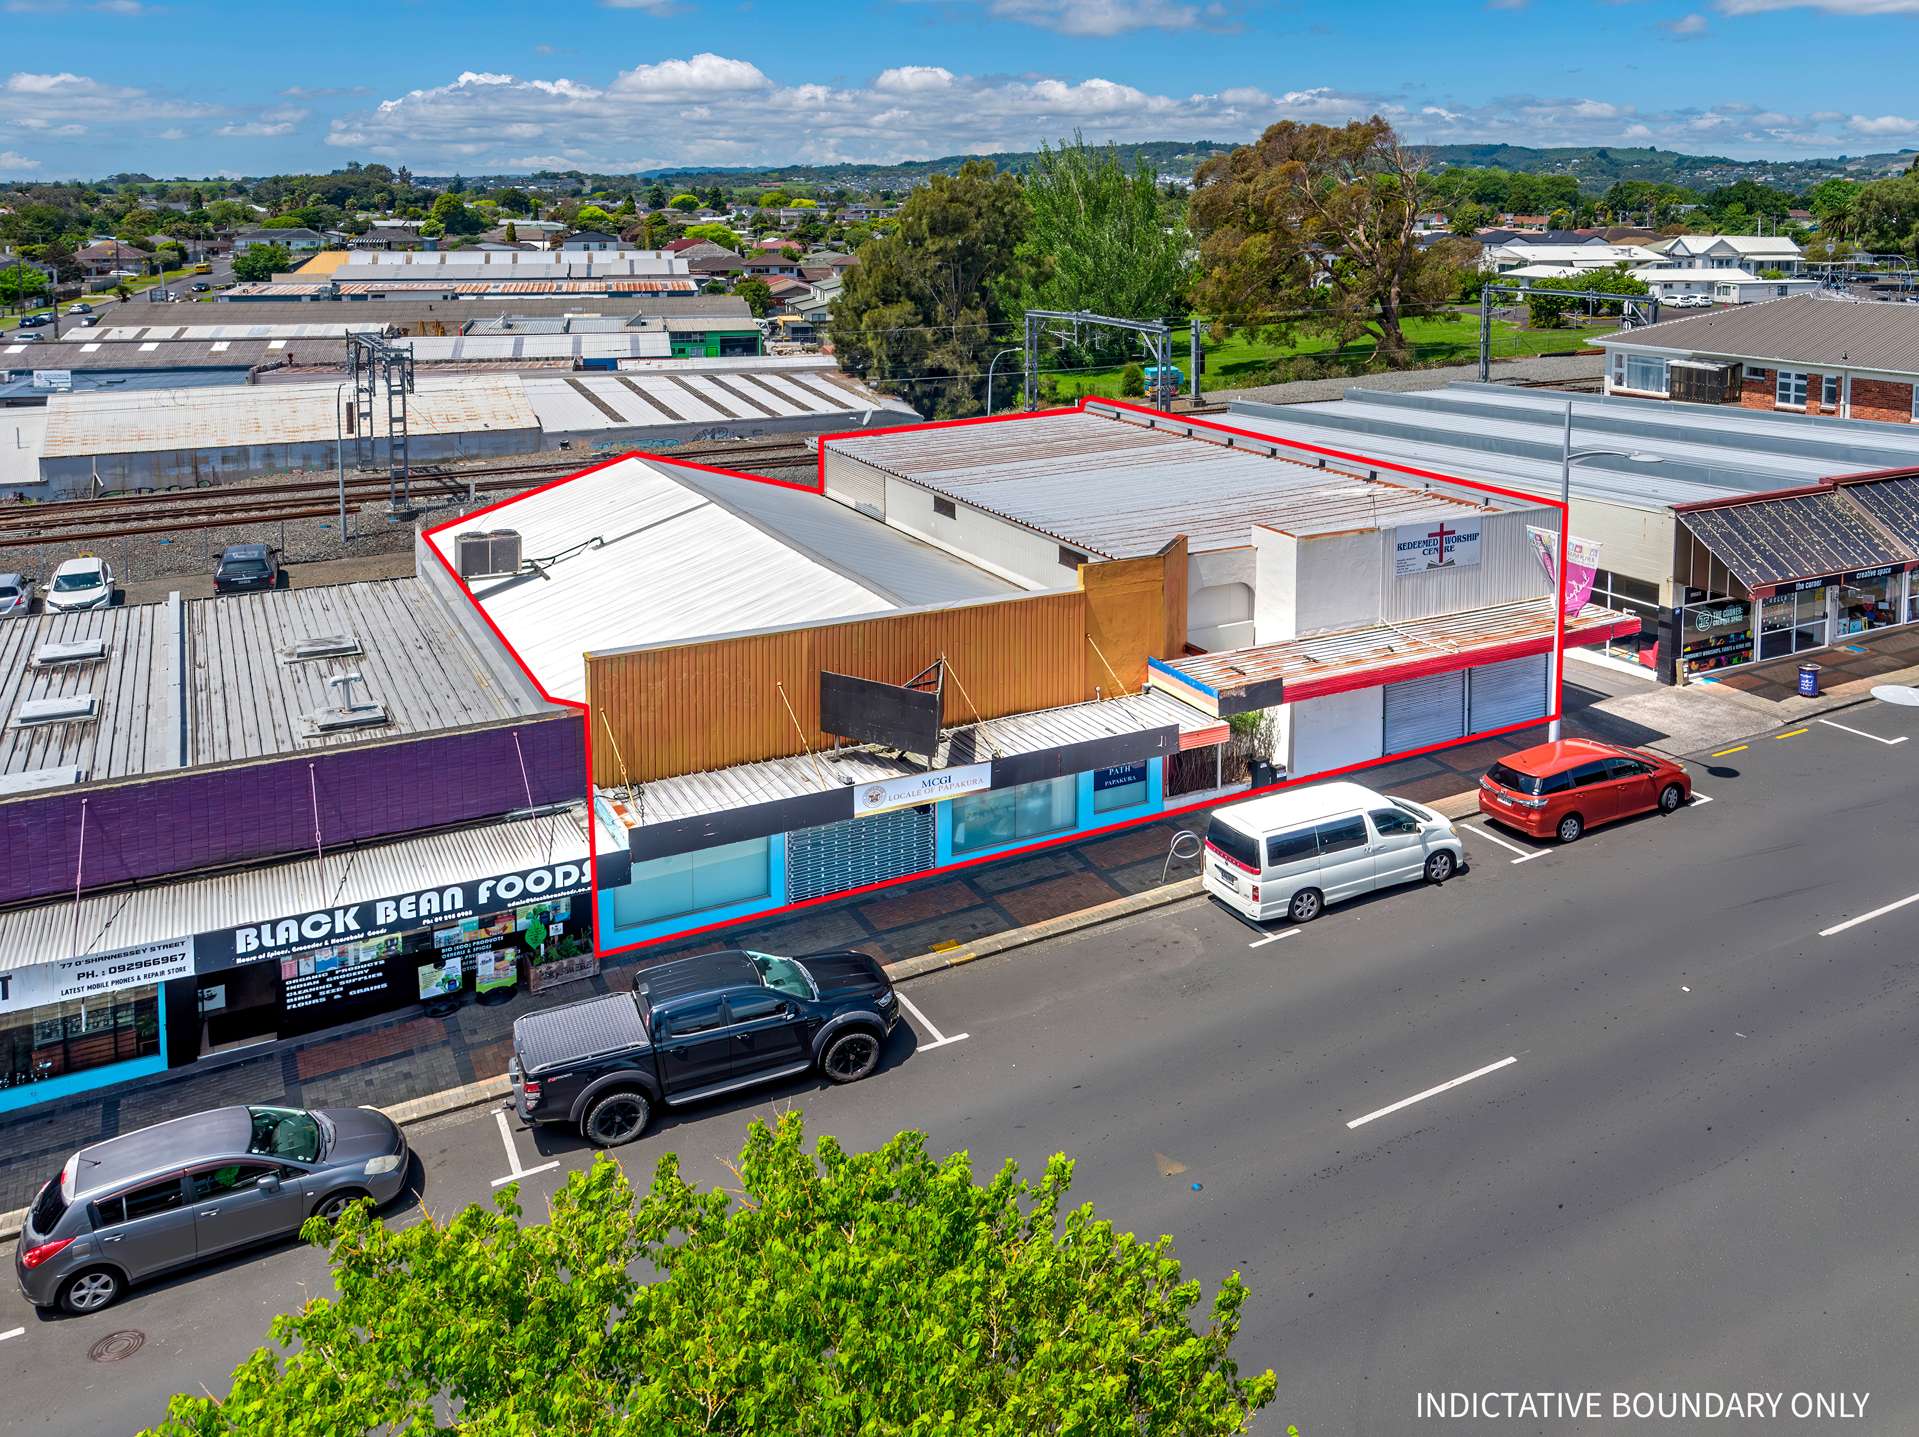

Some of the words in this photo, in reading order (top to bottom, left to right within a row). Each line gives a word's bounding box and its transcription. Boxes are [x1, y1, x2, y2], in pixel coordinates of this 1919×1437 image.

[1397, 538, 1439, 552] REDEEMED
[1444, 532, 1480, 545] WORSHIP
[1856, 568, 1877, 580] creative
[1877, 566, 1892, 577] space
[1795, 581, 1805, 591] the
[1805, 579, 1823, 590] corner
[1108, 764, 1131, 776] PATH
[921, 775, 952, 789] MCGI
[1104, 775, 1137, 787] PAPAKURA
[888, 789, 921, 802] LOCALE
[938, 777, 984, 793] PAPAKURA
[236, 906, 361, 954] BLACK
[376, 887, 464, 925] BEAN
[60, 962, 73, 970] 77
[150, 941, 187, 953] STREET
[77, 972, 98, 981] PH.
[108, 953, 187, 976] 092966967
[335, 960, 385, 975] PRODUCTS
[60, 985, 85, 997] LATEST
[86, 980, 109, 992] MOBILE
[110, 976, 136, 987] PHONES
[143, 971, 166, 980] REPAIR
[168, 965, 187, 975] STORE
[286, 979, 320, 991] INDIAN
[339, 972, 383, 986] SUPPLIES
